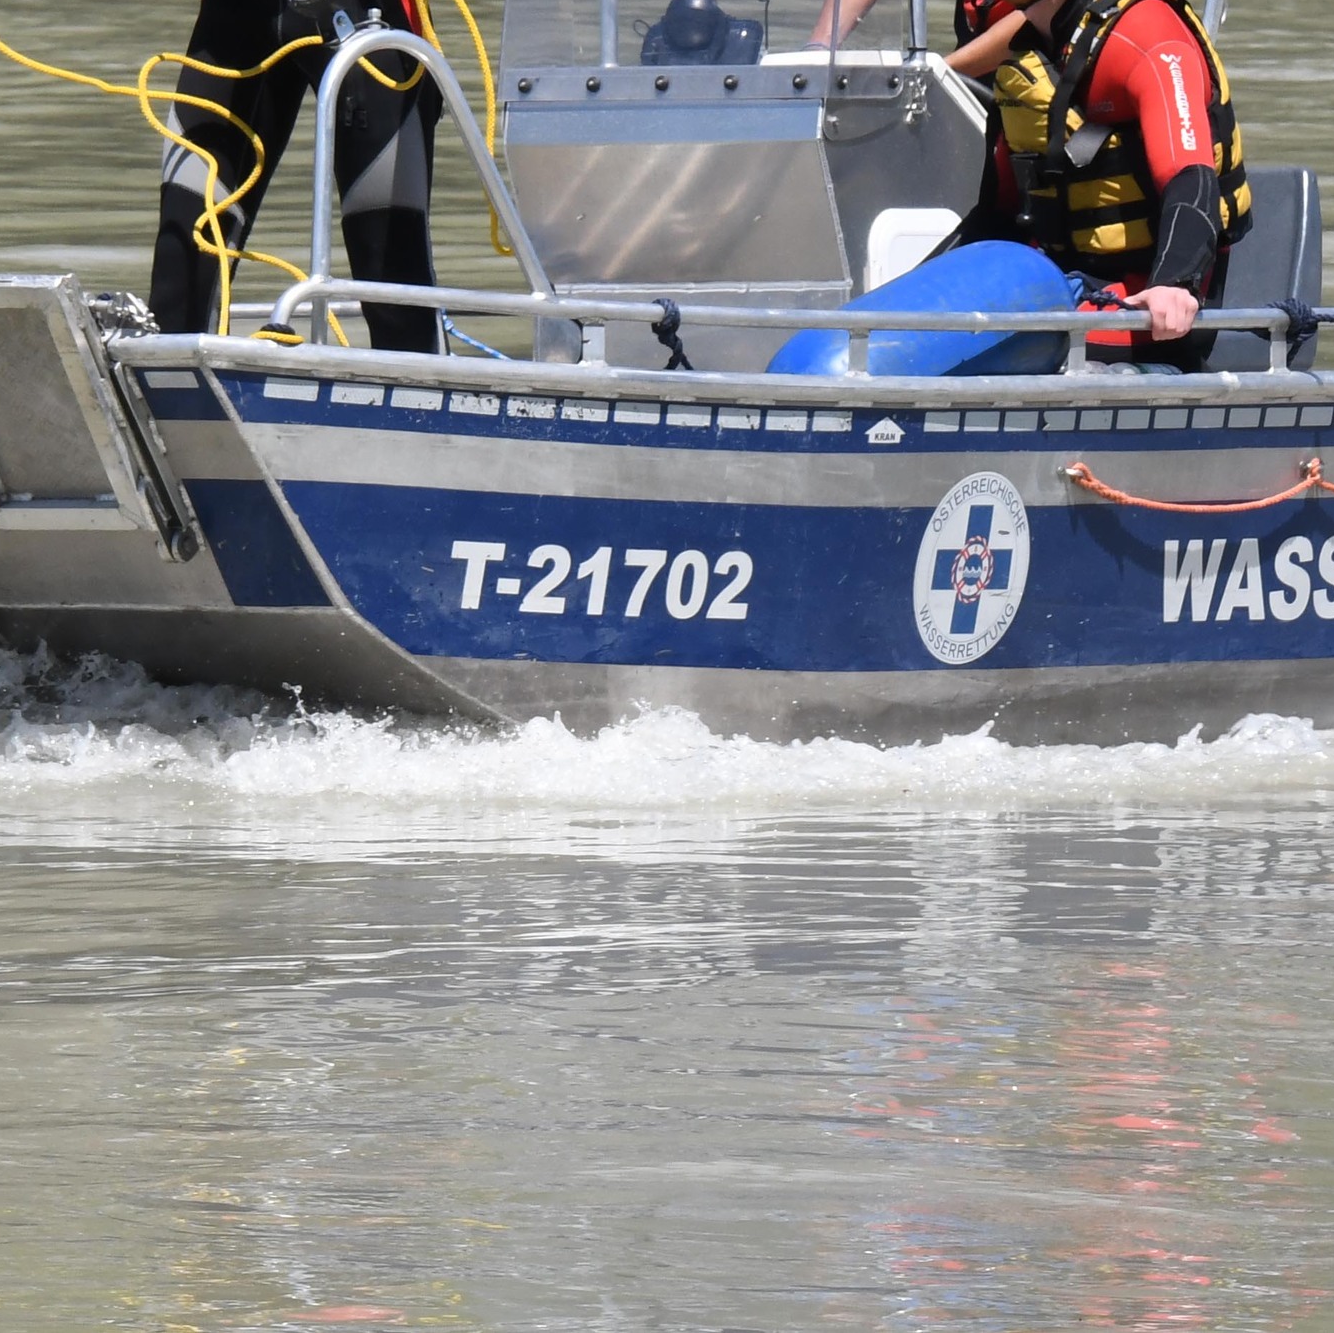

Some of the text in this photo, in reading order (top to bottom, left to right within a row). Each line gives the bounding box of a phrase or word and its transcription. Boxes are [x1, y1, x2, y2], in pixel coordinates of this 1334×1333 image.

[874, 433, 896, 441] KRAN
[932, 477, 1026, 536] ÖSTERREICHISCHE
[451, 540, 754, 619] T-21702
[919, 602, 1015, 659] WASSERRETTUNG
